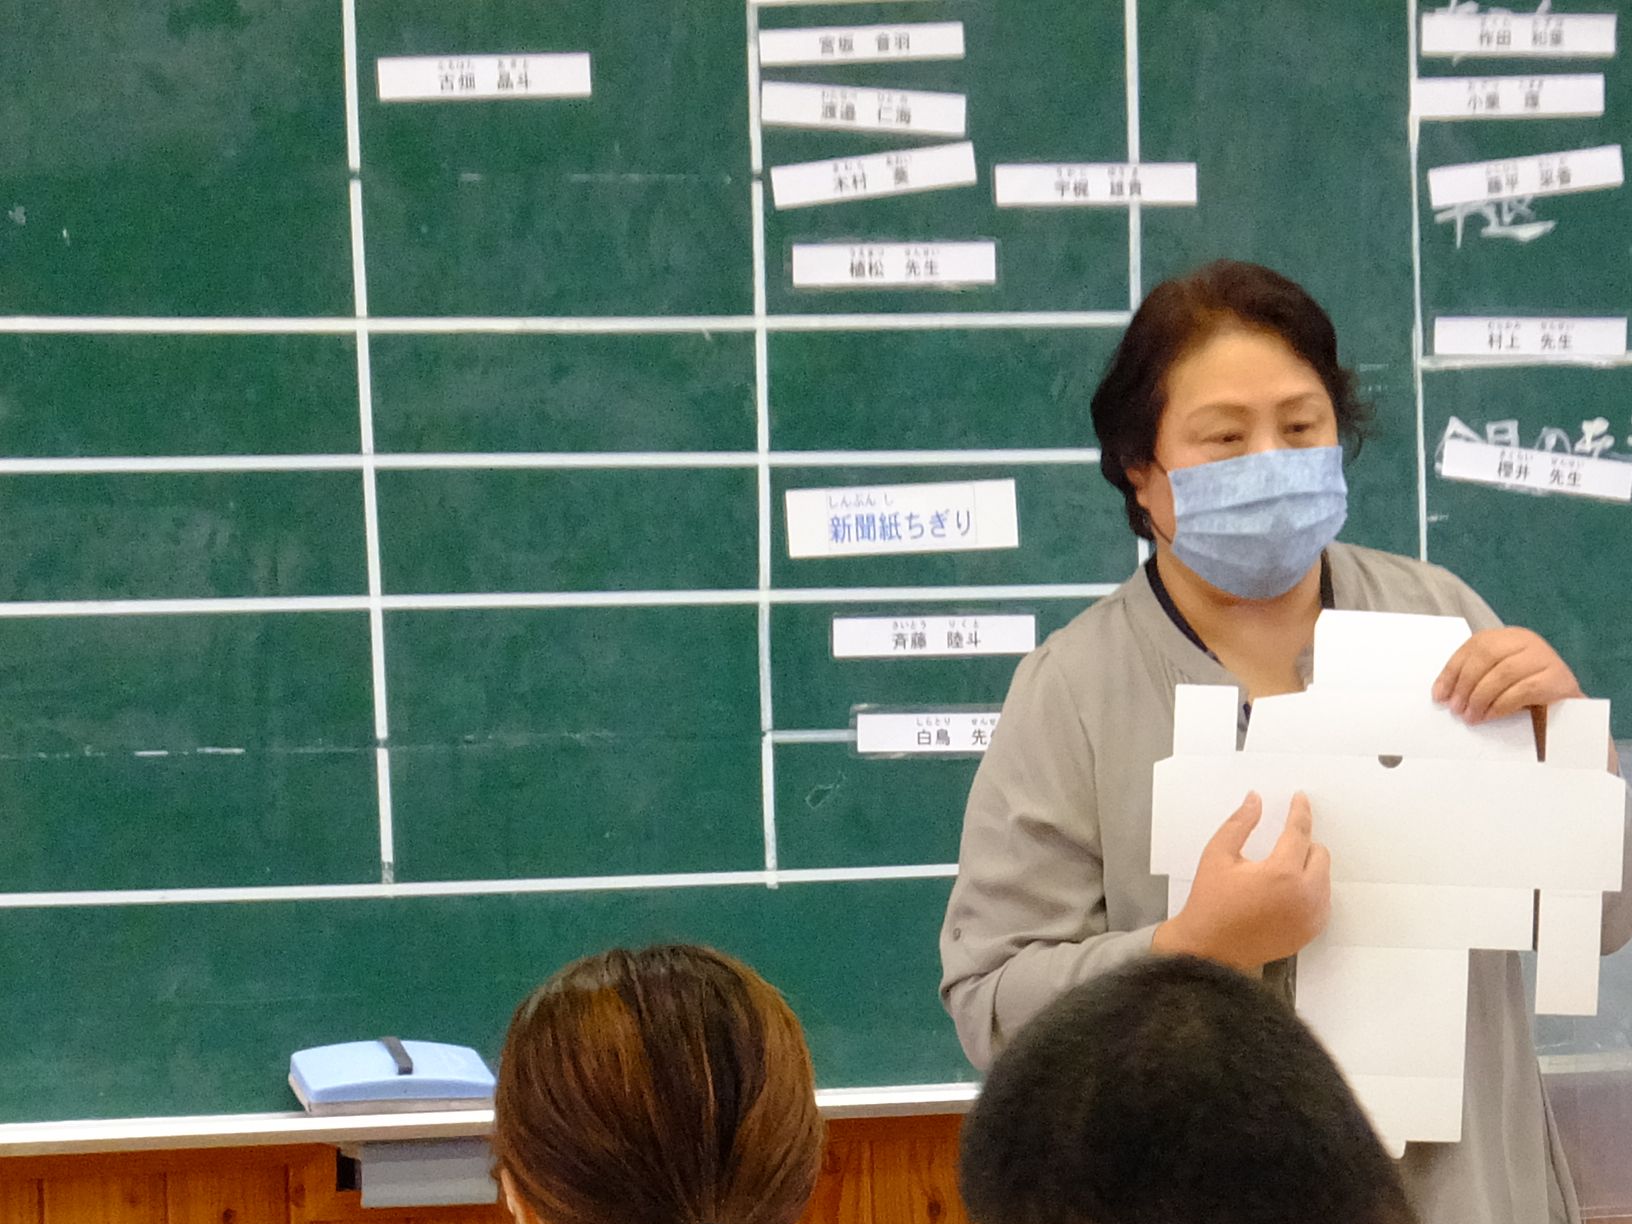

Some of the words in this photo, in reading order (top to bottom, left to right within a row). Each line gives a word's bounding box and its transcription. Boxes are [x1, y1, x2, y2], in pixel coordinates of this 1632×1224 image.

[905, 259, 940, 278] 先生
[1487, 333, 1521, 351] 村上
[1540, 333, 1574, 350] 先生
[1549, 468, 1582, 487] 先生
[828, 492, 877, 508] しんぶん
[829, 509, 972, 544] 新聞紙ちぎり
[946, 630, 982, 649] 陸斗
[916, 728, 951, 747] 白鳥
